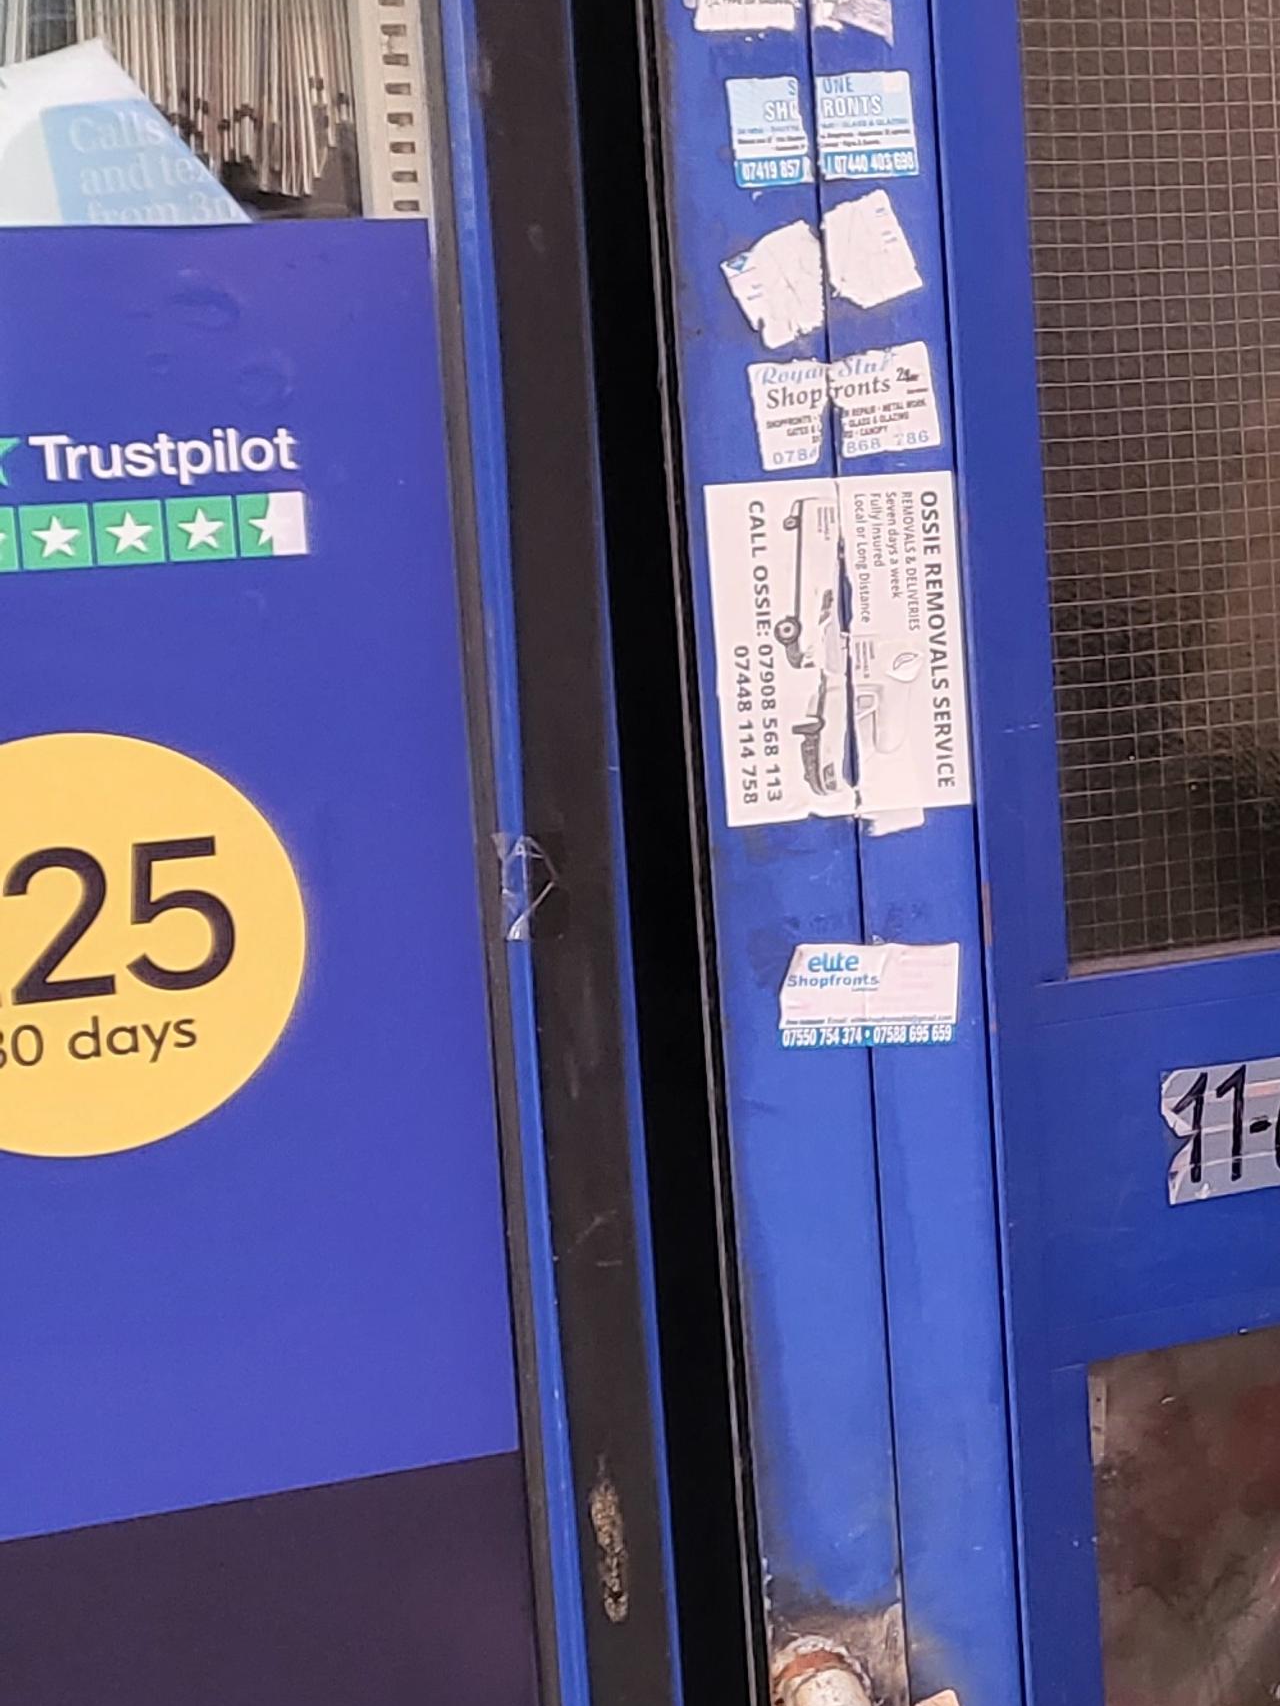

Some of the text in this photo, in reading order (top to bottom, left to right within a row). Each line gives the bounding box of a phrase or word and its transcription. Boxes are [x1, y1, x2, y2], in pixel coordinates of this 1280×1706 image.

[822, 94, 882, 123] RONTS
[68, 110, 166, 154] Calls
[79, 150, 153, 197] and
[28, 427, 302, 486] Trustpilot
[853, 492, 866, 521] Local
[868, 492, 882, 521] Fully
[884, 491, 898, 526] Seven
[855, 521, 865, 539] or
[886, 527, 900, 557] days
[854, 540, 869, 572] Long
[901, 490, 921, 632] REMOVALS & DELIVERIES
[857, 572, 871, 624] Distance
[889, 567, 901, 598] week
[749, 499, 784, 802] CALL OSSIE: 07908 568 113
[919, 490, 956, 788] OSSIE REMOVALS SERVICE
[733, 645, 759, 805] 07448 114 758
[807, 952, 860, 973] elite
[787, 973, 880, 990] Shopfronts
[67, 1015, 198, 1063] days
[782, 1028, 817, 1047] 07550
[819, 1027, 840, 1045] 754
[841, 1026, 862, 1045] 374
[908, 1025, 930, 1042] 695
[931, 1024, 952, 1042] 659
